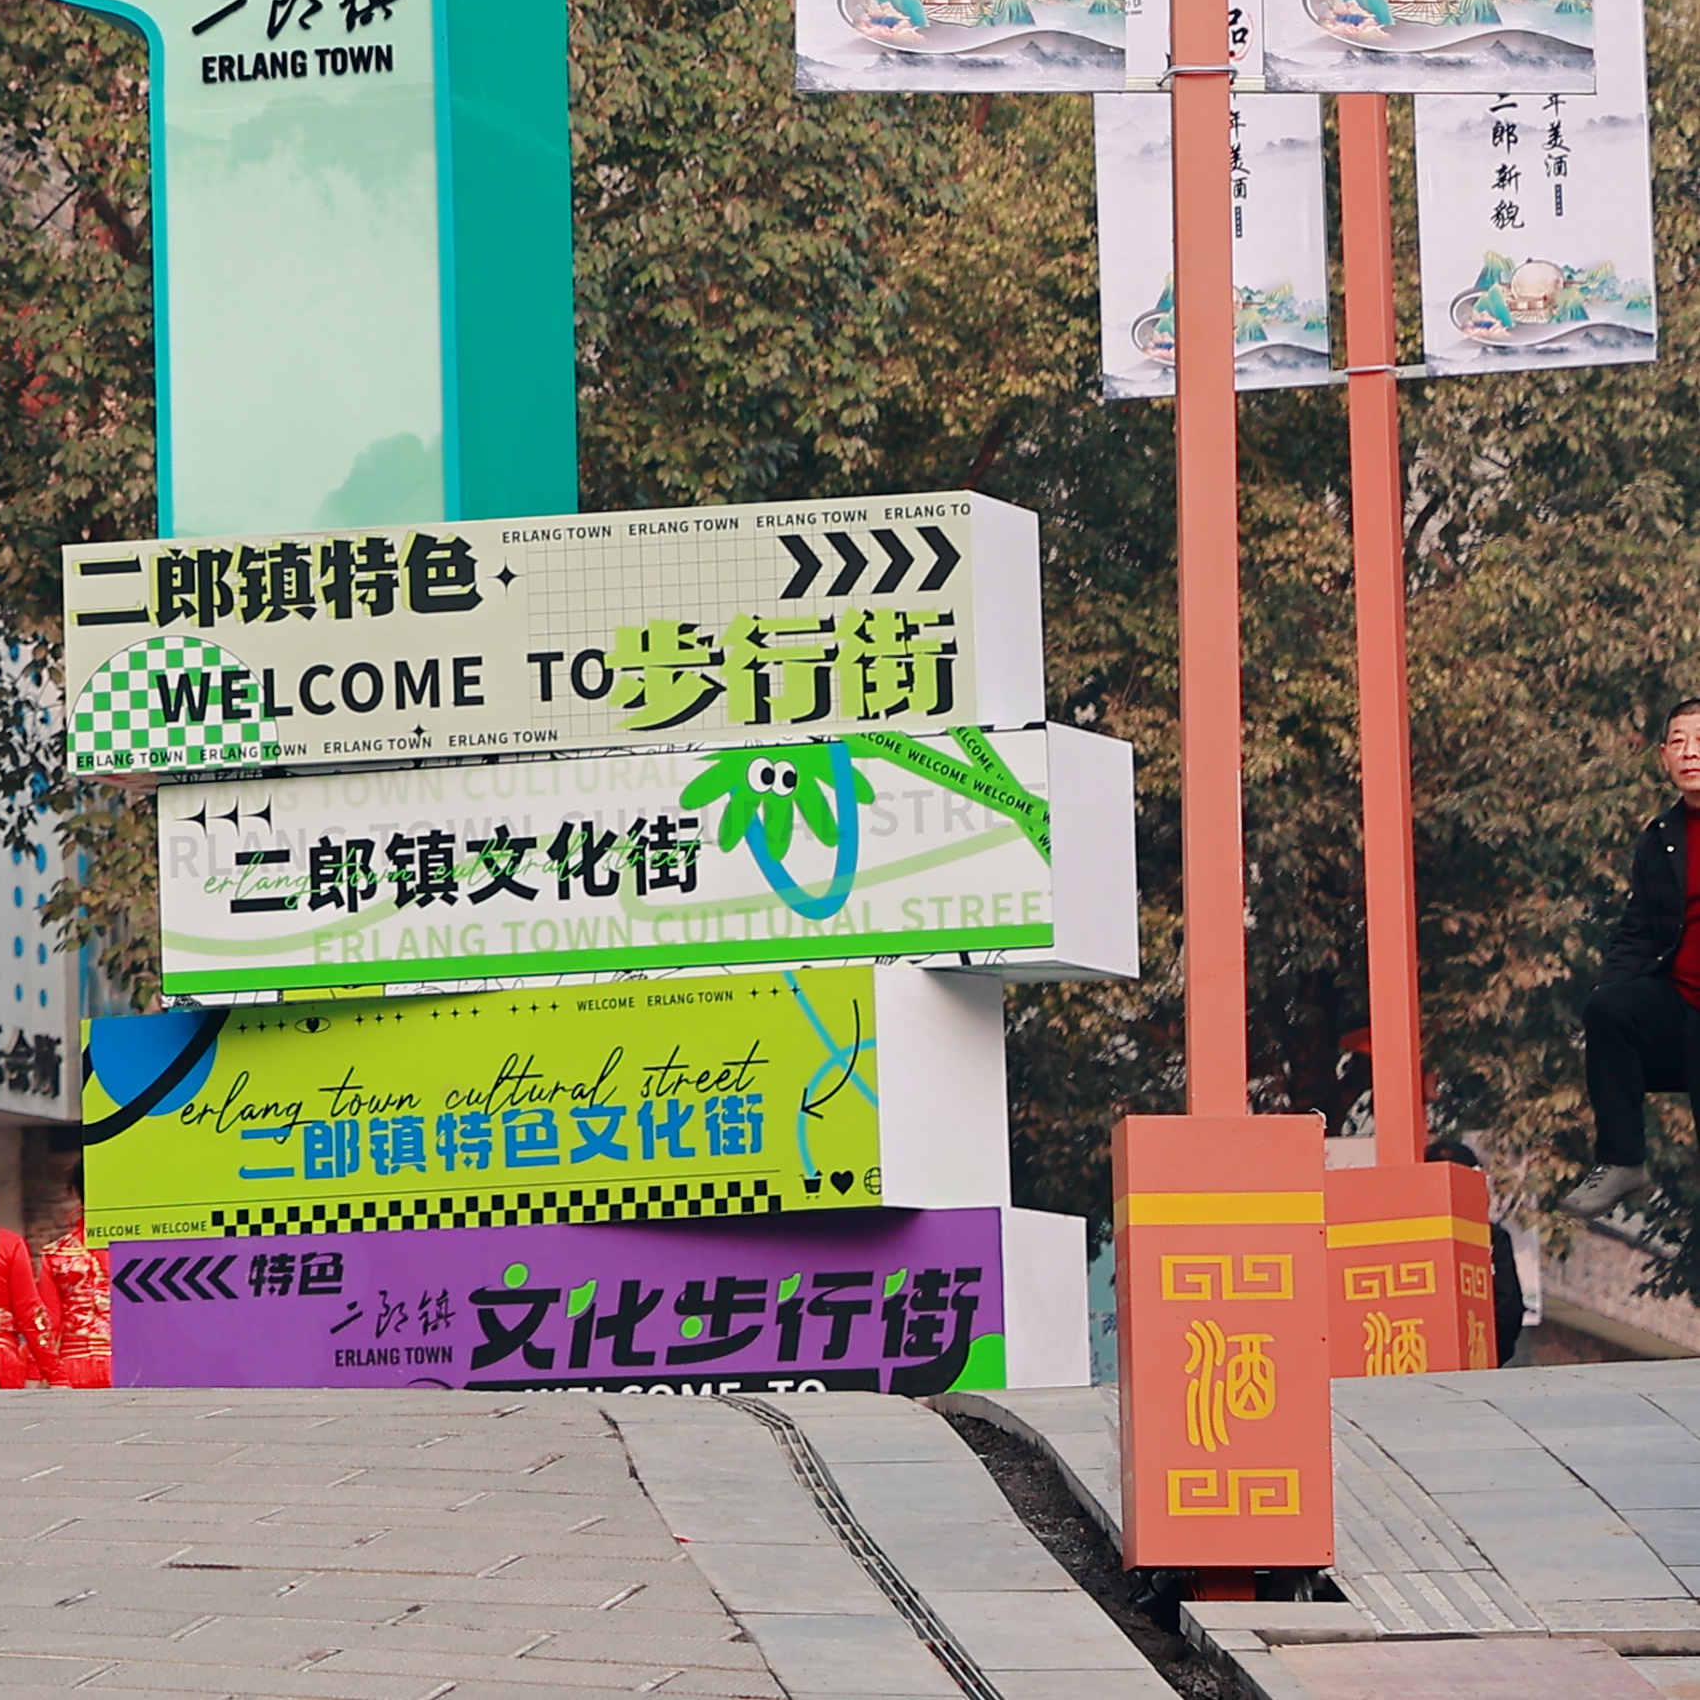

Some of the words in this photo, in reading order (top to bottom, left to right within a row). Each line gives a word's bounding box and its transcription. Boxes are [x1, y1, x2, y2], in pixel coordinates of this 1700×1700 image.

[201, 51, 307, 84] ERLANG
[315, 44, 393, 76] TOWN
[502, 526, 562, 544] ERLANG
[567, 525, 613, 540] TOWN
[628, 519, 690, 536] ERLANG
[693, 517, 740, 532] TOWN
[756, 513, 817, 528] ERLANG
[821, 509, 868, 525] TOWN
[884, 505, 945, 520] ERLANG
[72, 531, 484, 628] 二郎镇特色
[156, 656, 485, 723] WELCOME
[527, 647, 615, 702] TO
[603, 607, 959, 732] 步行街
[76, 753, 135, 768] ERLANG
[139, 749, 184, 765] TOWN
[199, 745, 259, 761] ERLANG
[262, 741, 308, 757] TOWN
[323, 738, 383, 754] ERLANG
[387, 735, 432, 751] TOWN
[449, 731, 509, 747] ERLANG
[512, 729, 559, 744] TOWN
[856, 731, 902, 755] LCOME
[908, 748, 968, 784] WELCOME
[973, 779, 1034, 815] WELCOME
[230, 815, 701, 913] 二郎镇文化街
[313, 923, 487, 965] ERLANG
[502, 916, 634, 955] TOWN
[901, 890, 1052, 930] STREE
[576, 997, 635, 1012] WELCOME
[647, 992, 694, 1007] ERLANG
[698, 990, 733, 1004] TOWN
[180, 1070, 326, 1144] erlang
[319, 1066, 421, 1117] town
[445, 1045, 624, 1117] cultural
[640, 1039, 770, 1099] street
[239, 1092, 765, 1181] 二郎镇特色文化街
[86, 1223, 141, 1238] WELCOME
[151, 1220, 207, 1235] WELCOME
[248, 1251, 345, 1297] 特色
[335, 1348, 399, 1368] ERLANG
[404, 1345, 453, 1364] TOWN
[468, 1261, 983, 1385] 文化步行街
